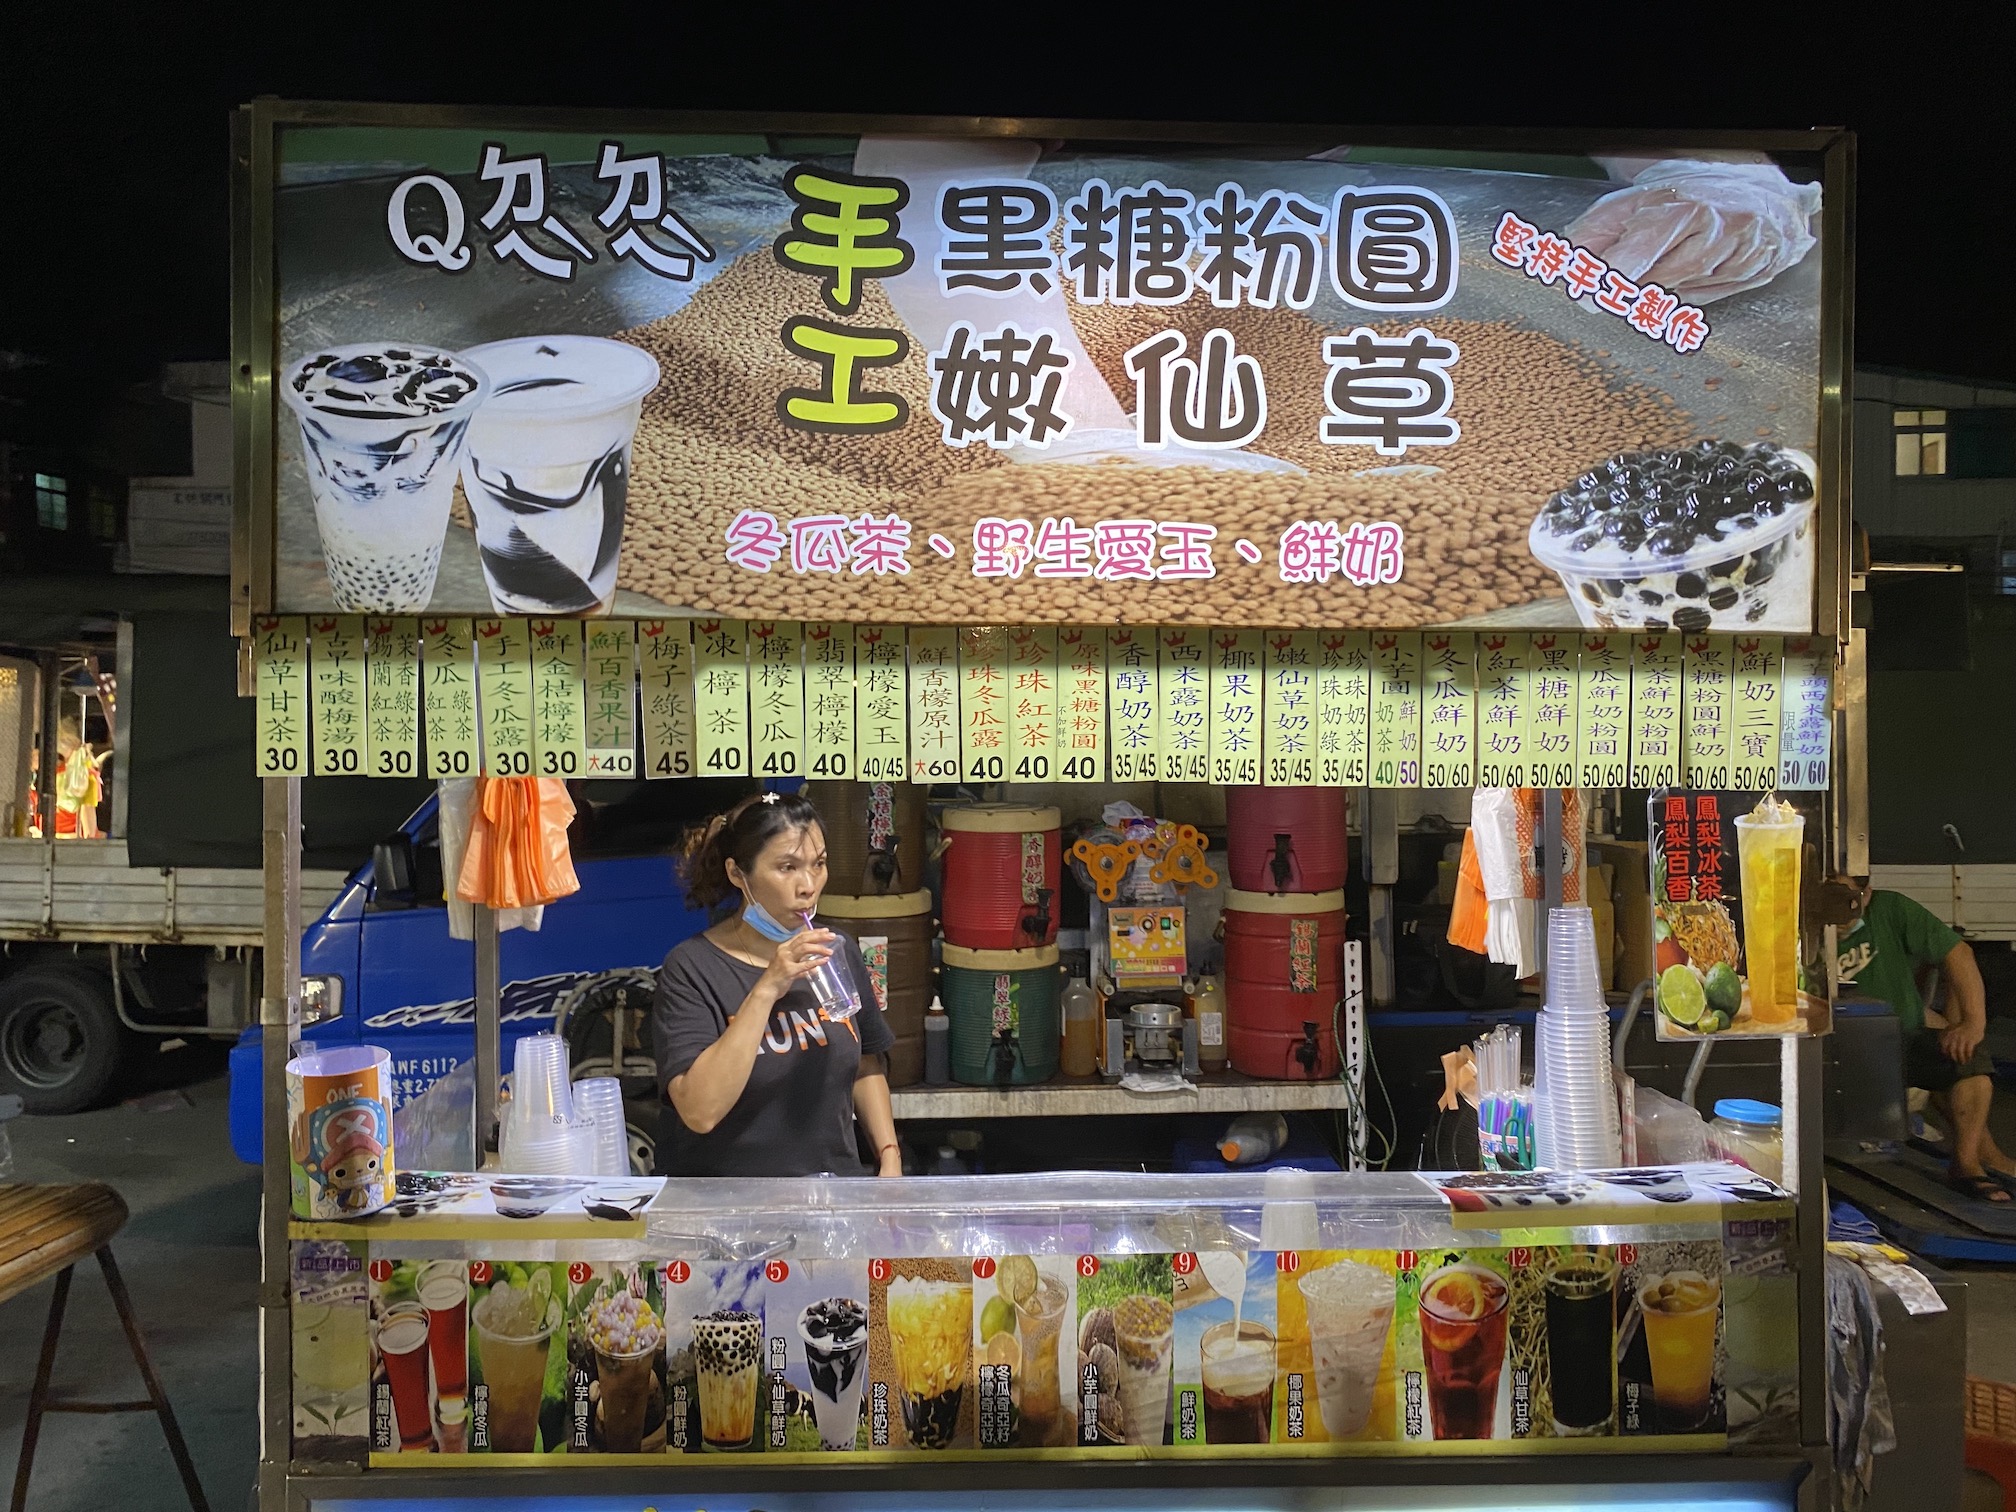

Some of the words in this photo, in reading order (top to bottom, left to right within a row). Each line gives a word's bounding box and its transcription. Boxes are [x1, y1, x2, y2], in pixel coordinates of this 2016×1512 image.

[939, 183, 1453, 307] 黑糖粉圓
[781, 170, 907, 428] 手工
[1493, 213, 1709, 352] 堅持手工製作
[933, 327, 1457, 450] 嫩仙草
[262, 632, 298, 742] 仙草甘茶
[486, 635, 528, 747] 手工冬瓜露
[537, 633, 576, 743] 鮮金桔檸檬
[589, 631, 631, 746] 鮮百香果汁
[647, 636, 688, 746] 梅子綠茶
[702, 633, 741, 734] 凍檸茶
[757, 636, 797, 743] 檸檬冬瓜
[811, 638, 849, 745] 翡翠檸檬
[1380, 648, 1415, 695] 小芋圓
[864, 642, 901, 744] 檸檬愛玉
[916, 648, 953, 749] 鮮香檬原汁
[966, 646, 1005, 749] 珍珠冬瓜露
[1014, 641, 1052, 747] 珍珠紅茶
[1070, 644, 1102, 750] 原味黑糖粉圓
[1116, 643, 1153, 748] 香醇奶茶
[1167, 645, 1204, 750] 西米露奶茶
[1218, 648, 1255, 752] 椰果奶茶
[1272, 648, 1310, 753] 嫩仙草奶茶
[1320, 649, 1343, 753] 珍珠奶綠
[1344, 648, 1367, 754] 珍珠奶茶
[1429, 648, 1468, 753] 冬瓜鮮奶
[1484, 651, 1522, 754] 紅茶鮮奶
[1533, 650, 1571, 753] 黑糖鮮奶
[1586, 649, 1624, 756] 冬瓜鮮奶粉圓
[1638, 651, 1677, 756] 紅茶鮮奶粉圓
[1689, 651, 1726, 757] 黑糖粉圓鮮奶
[1739, 652, 1776, 759] 鮮奶三寶
[1782, 712, 1795, 752] 限量
[265, 748, 297, 771] 30
[325, 749, 358, 772] 30
[378, 751, 412, 773] 30
[436, 751, 469, 773] 30
[496, 752, 529, 775] 30
[544, 751, 576, 773] 30
[656, 752, 689, 774] 45
[707, 748, 740, 770] 40
[763, 751, 796, 774] 40
[813, 753, 846, 775] 40
[863, 757, 903, 779] 40/45
[970, 756, 1003, 779] 40
[1015, 756, 1048, 778] 40
[1063, 757, 1095, 779] 40
[1116, 754, 1156, 780] 35/45
[1167, 755, 1206, 779] 35/45
[1215, 759, 1255, 782] 35/45
[1271, 758, 1311, 782] 35/45
[1322, 759, 1363, 784] 35/45
[1376, 761, 1417, 785] 40/50
[1428, 764, 1469, 788] 50/60
[1482, 765, 1523, 788] 50/60
[1531, 764, 1572, 788] 50/60
[1583, 764, 1623, 787] 50/60
[1632, 764, 1672, 788] 50/60
[1686, 767, 1727, 789] 50/60
[1735, 766, 1775, 790] 50/60
[1782, 760, 1826, 785] 50/60
[1664, 796, 1692, 901] 鳳梨百香
[1695, 795, 1722, 901] 鳳梨冰茶
[728, 1008, 828, 1054] UN
[376, 1262, 383, 1280] 1
[473, 1261, 486, 1281] 2
[573, 1262, 584, 1282] 3
[672, 1263, 683, 1281] 4
[770, 1261, 781, 1280] 5
[872, 1259, 883, 1279] 6
[978, 1257, 989, 1276] 7
[1082, 1256, 1094, 1275] 8
[1179, 1253, 1190, 1272] 9
[1279, 1252, 1298, 1272] 10
[1400, 1251, 1415, 1270] 11
[1509, 1247, 1527, 1266] 12
[1616, 1245, 1635, 1264] 13
[574, 1370, 588, 1447] 小芋圓冬瓜
[673, 1386, 687, 1447] 粉圓鮮奶
[873, 1383, 888, 1445] 珍珠奶茶
[1084, 1363, 1098, 1440] 小芋圓鮮奶
[1182, 1393, 1195, 1438] 鮮奶茶
[1288, 1375, 1303, 1436] 椰果奶茶
[1514, 1370, 1529, 1432] 仙草甘茶
